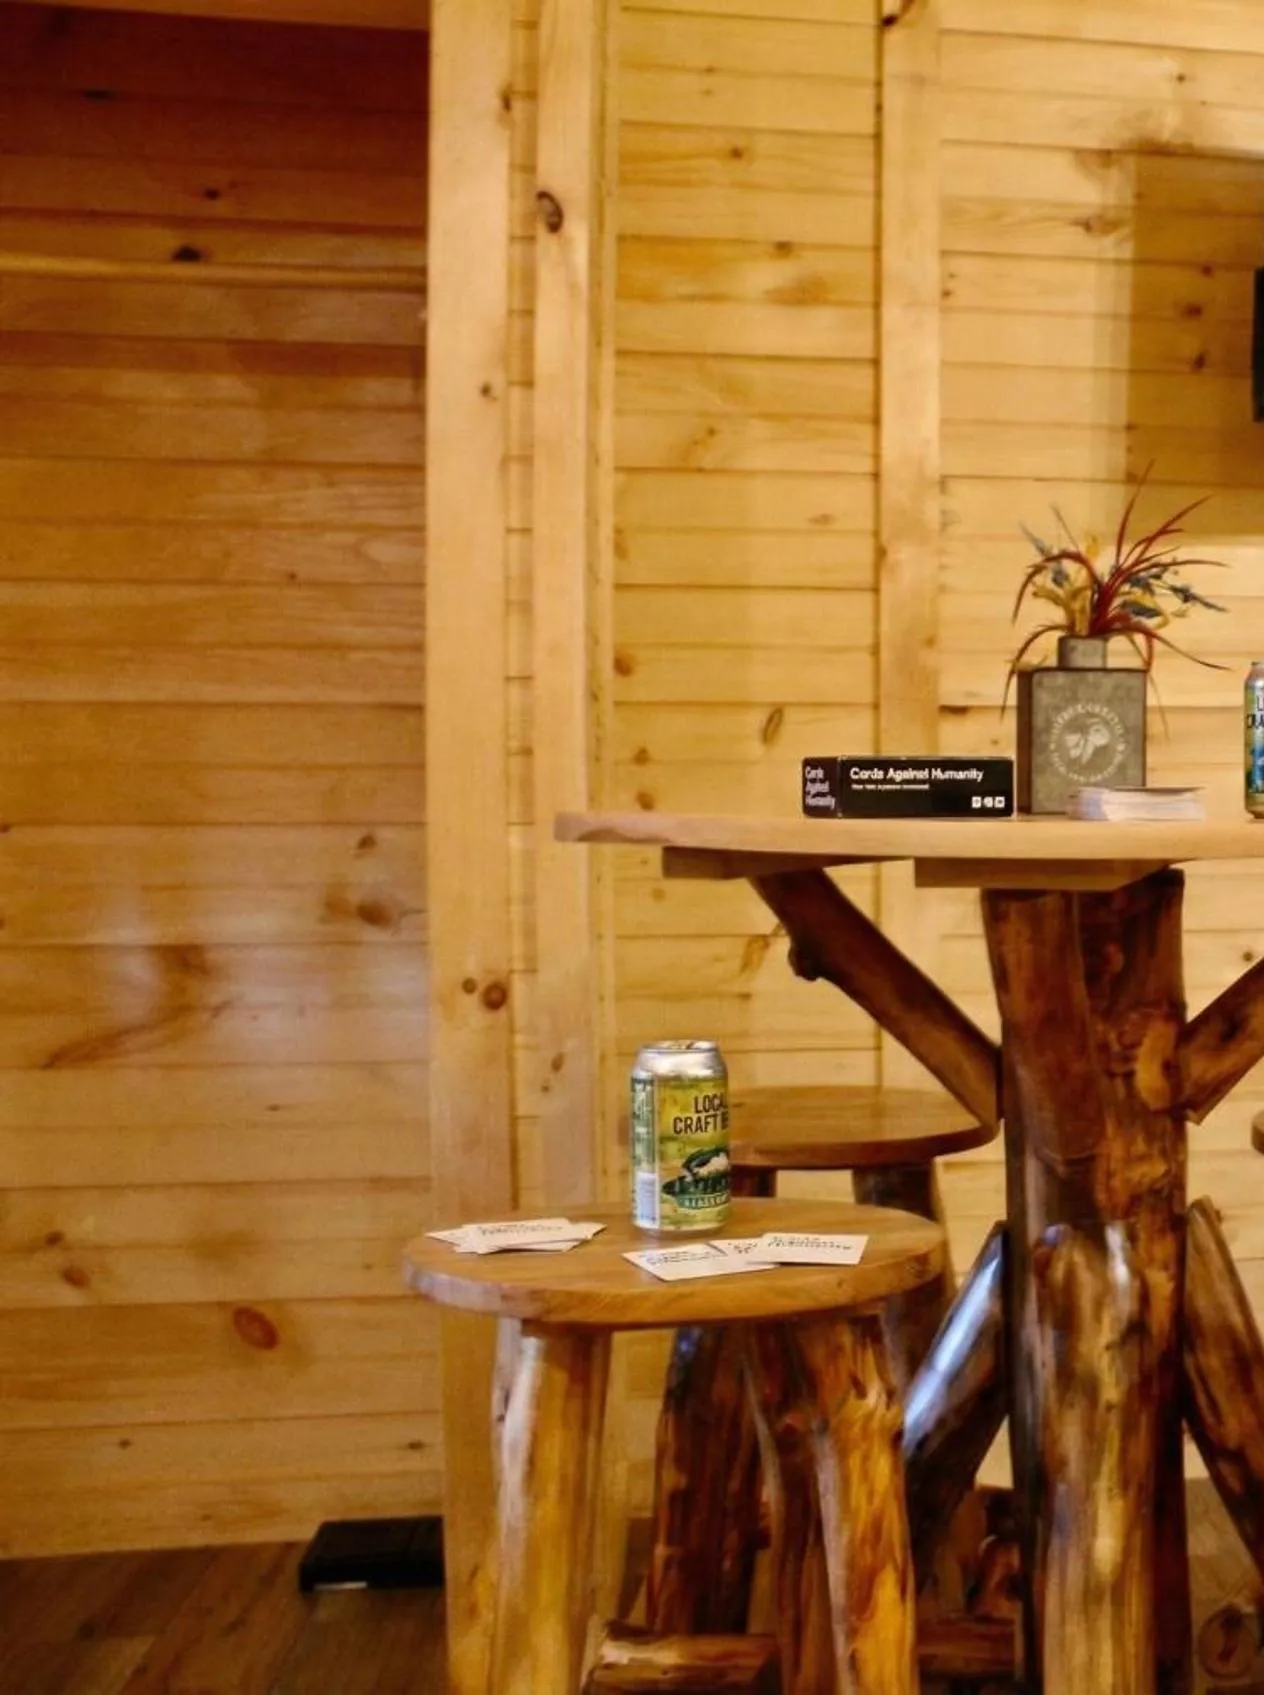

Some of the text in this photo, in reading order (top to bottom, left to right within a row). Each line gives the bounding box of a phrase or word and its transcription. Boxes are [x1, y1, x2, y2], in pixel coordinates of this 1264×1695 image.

[886, 767, 929, 782] Against
[931, 767, 984, 782] Humanity
[673, 1113, 719, 1134] CRAFT
